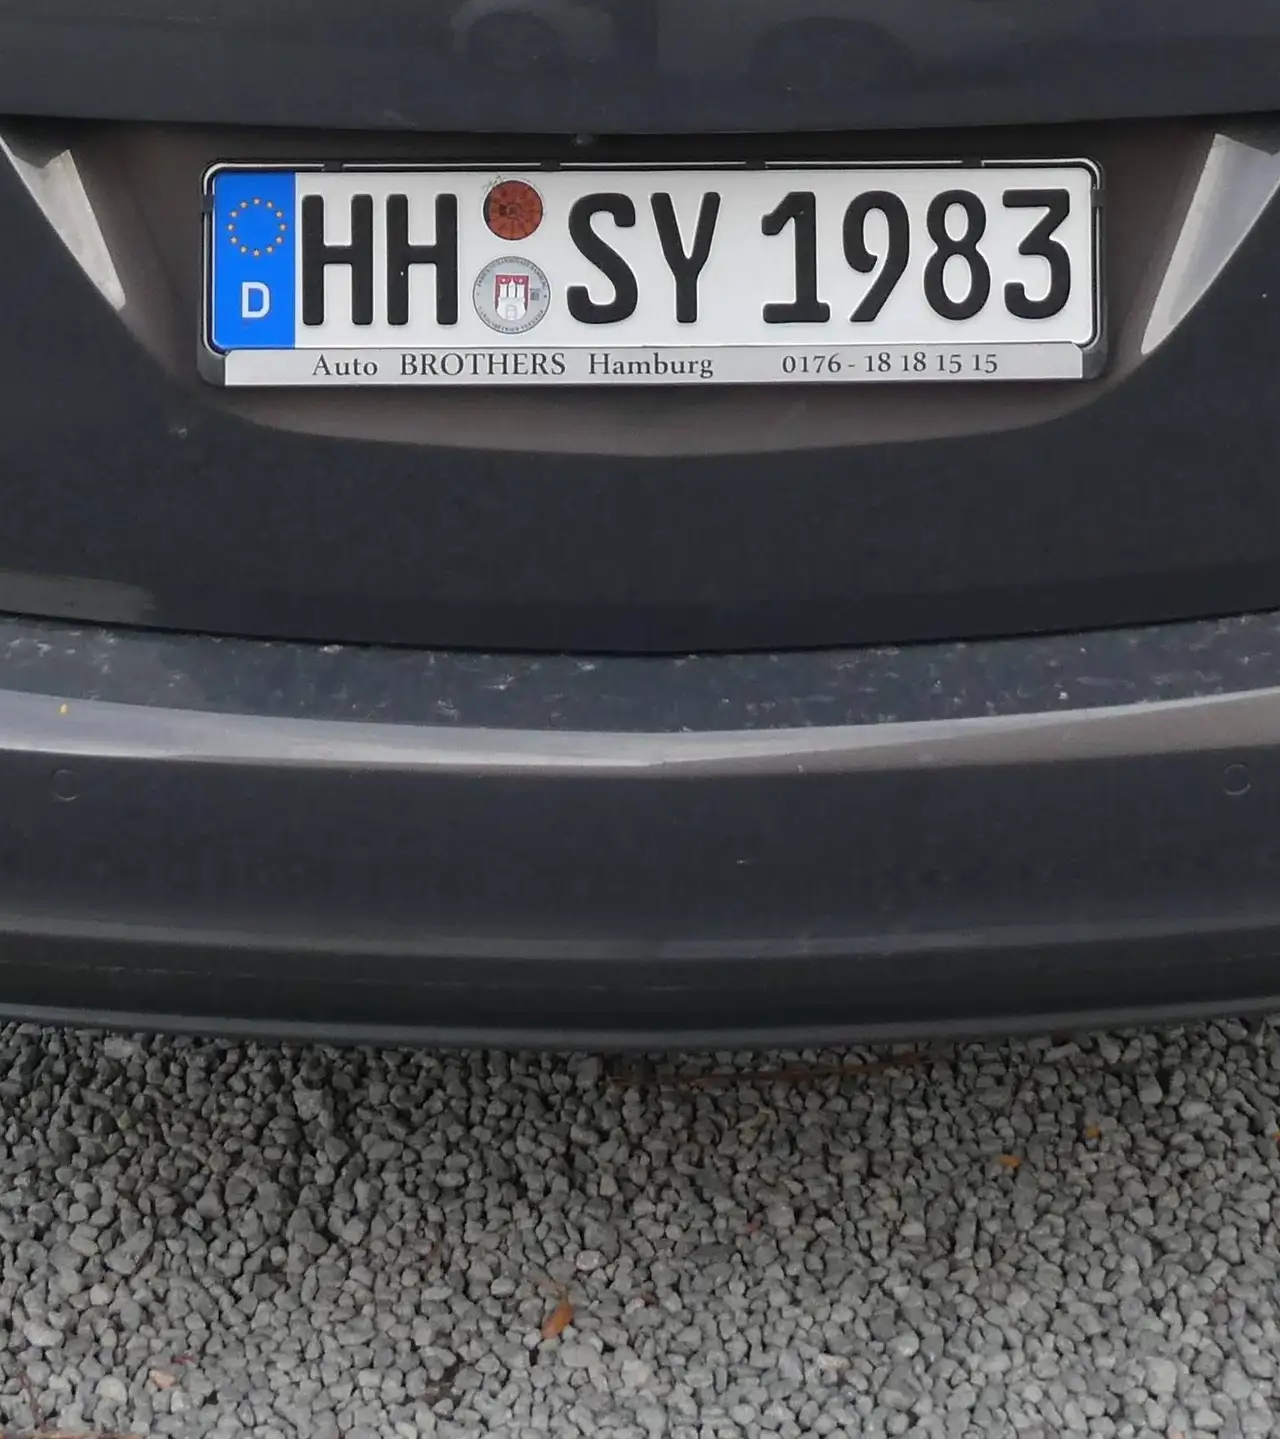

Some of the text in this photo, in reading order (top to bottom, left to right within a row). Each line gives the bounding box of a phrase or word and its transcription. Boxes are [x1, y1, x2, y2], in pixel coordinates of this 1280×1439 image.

[300, 188, 1071, 327] HH SY 1983
[240, 281, 270, 319] D
[312, 354, 378, 376] Auto
[400, 352, 566, 376] BROTHERS
[588, 352, 714, 379] Hamburg
[864, 352, 892, 373] 18
[900, 351, 928, 372] 18
[936, 354, 963, 374] 15
[972, 353, 999, 374] 15
